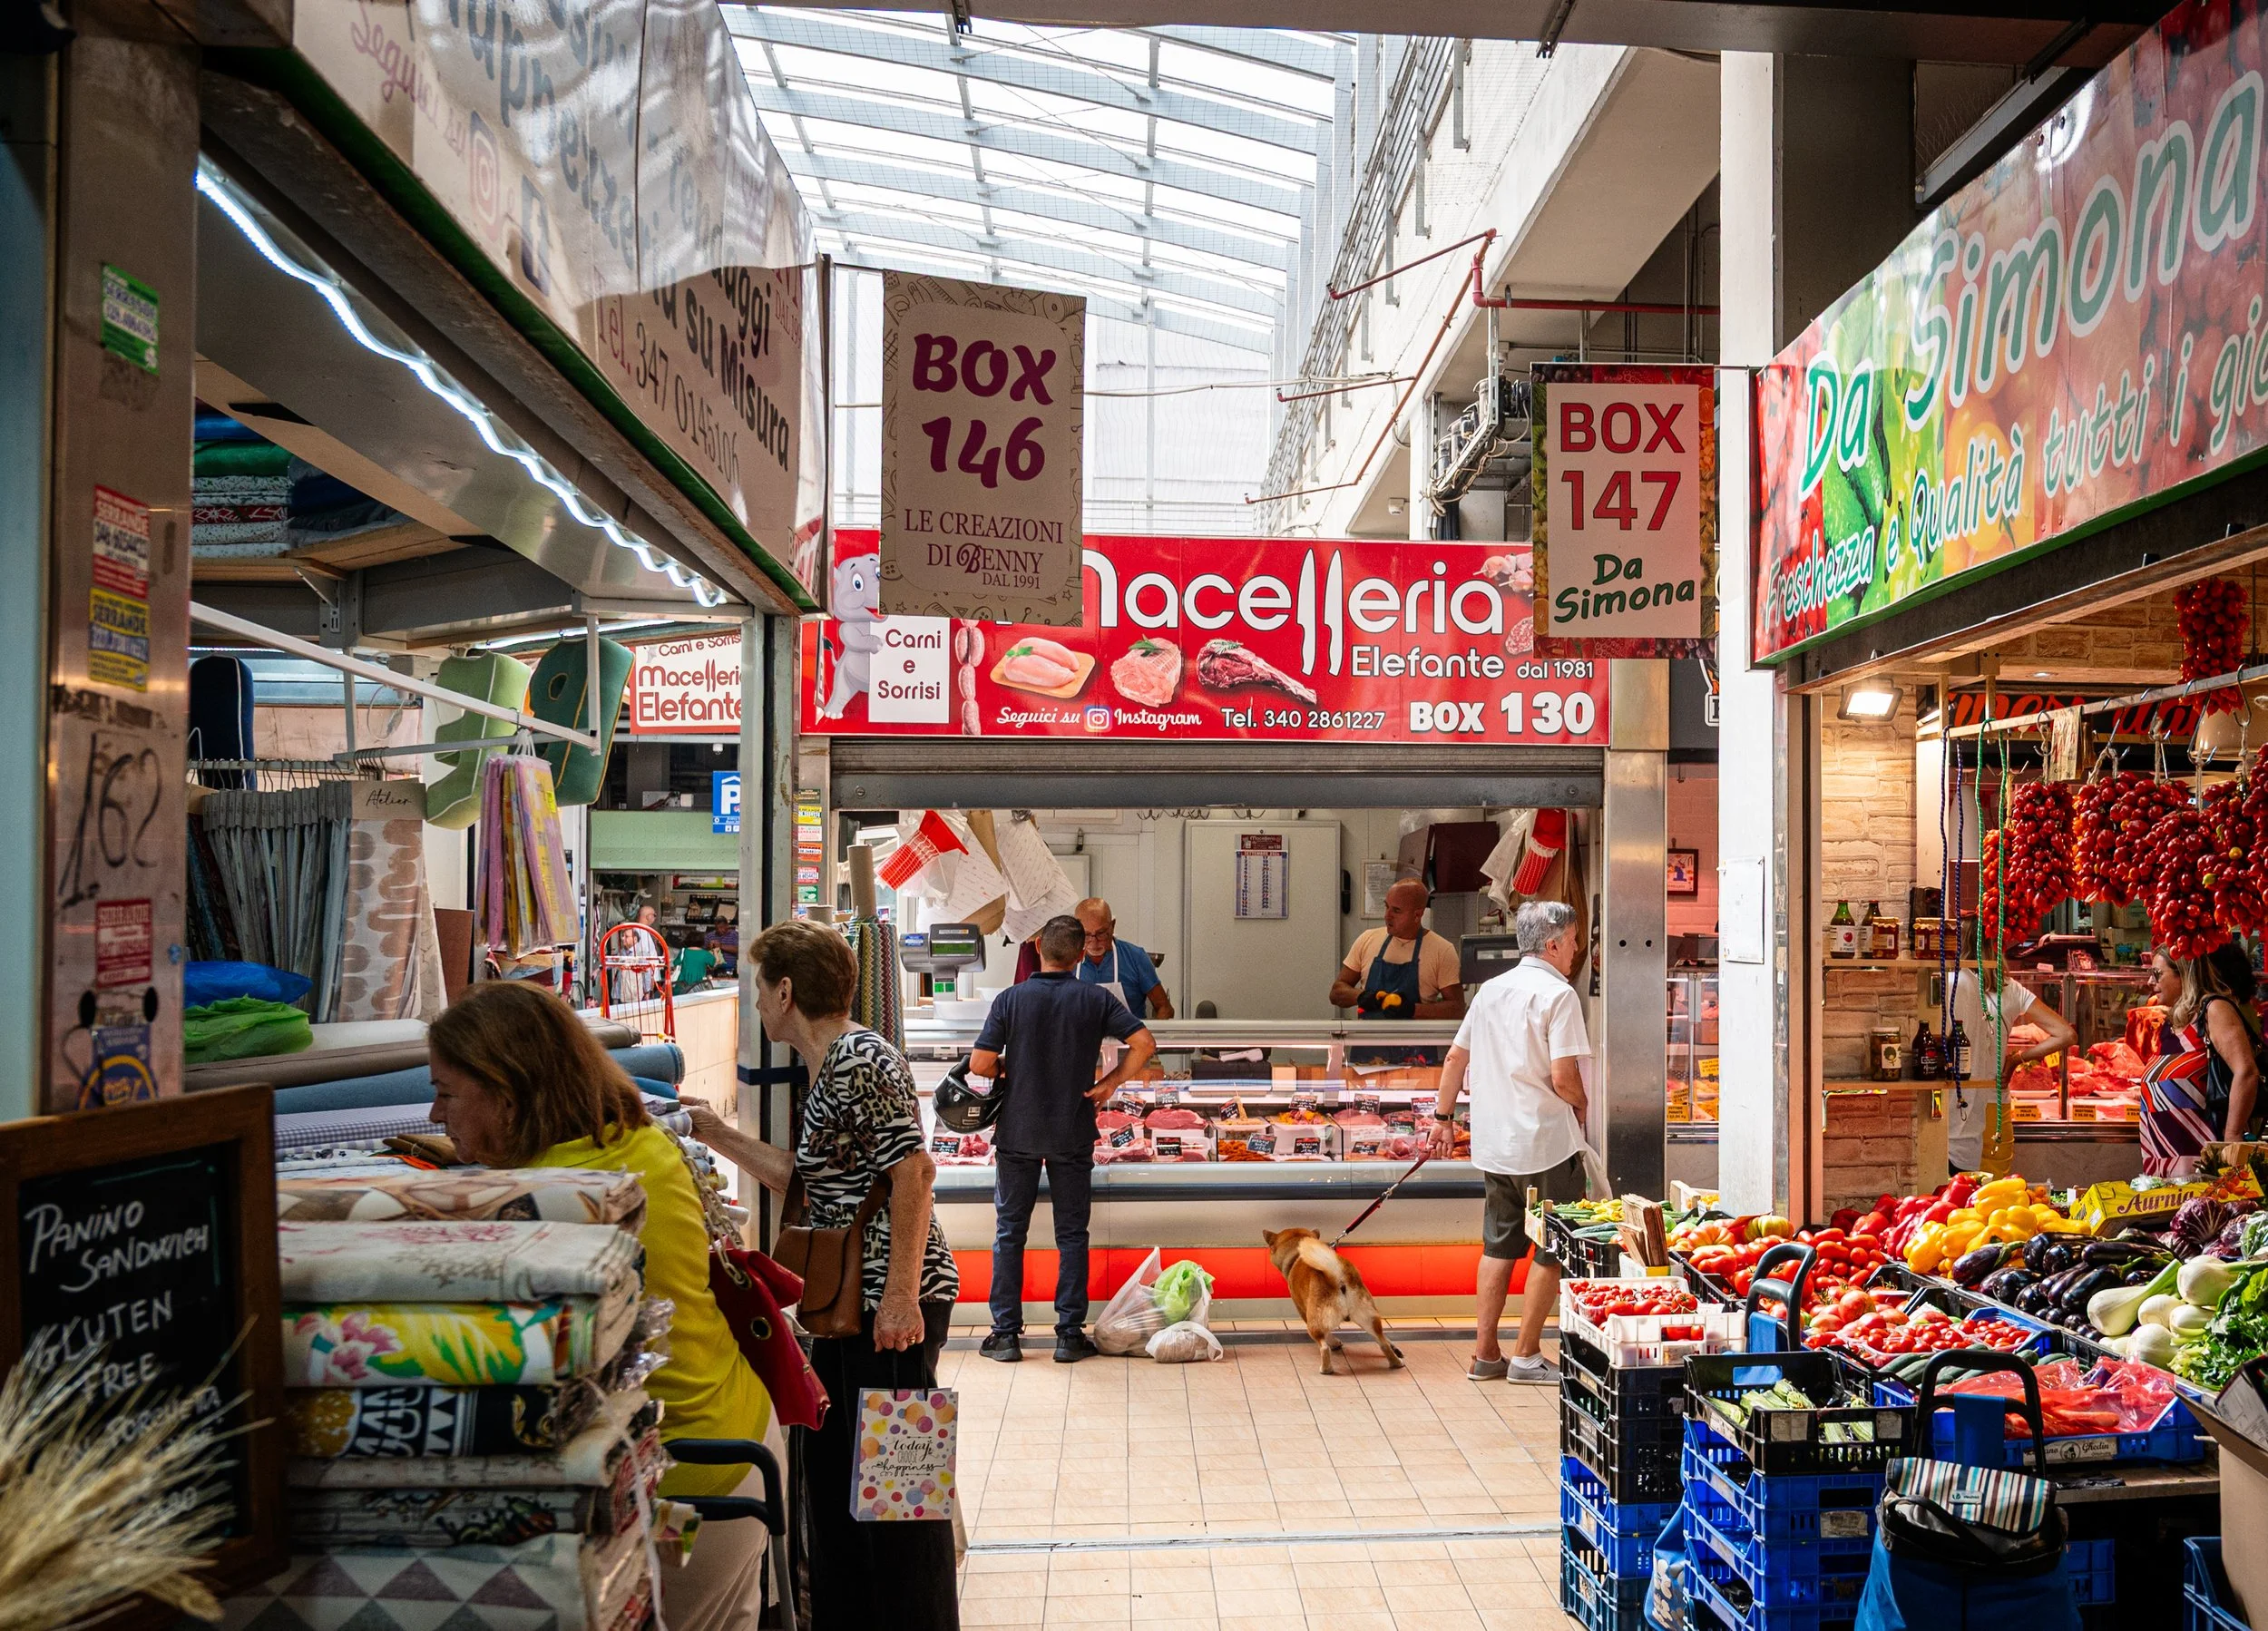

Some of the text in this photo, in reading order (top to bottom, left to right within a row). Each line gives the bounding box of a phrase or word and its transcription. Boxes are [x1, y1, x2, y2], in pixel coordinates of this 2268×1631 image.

[1798, 70, 2265, 503] Da Simona
[636, 321, 670, 412] 347
[686, 287, 715, 379] su
[720, 324, 790, 473] Misura
[912, 332, 1057, 406] BOX
[1560, 402, 1686, 454] BOX
[921, 415, 1046, 489] 146
[1561, 470, 1681, 531] 147
[1764, 523, 1875, 635] Freschezza
[1885, 514, 1901, 573] e
[1909, 424, 2026, 571] Qualità
[2043, 353, 2156, 500] tutti
[2169, 334, 2193, 448] i
[904, 508, 1064, 544] LE CREAZIONI
[927, 542, 1044, 574] DI BENNY
[1592, 553, 1643, 586] Da
[982, 571, 1041, 590] DAL 1991
[1553, 579, 1695, 623] Simona
[659, 635, 741, 656] Carni e Sorris
[885, 628, 942, 649] Carni
[639, 659, 741, 692] Macelleri
[903, 660, 915, 674] e
[1351, 645, 1595, 679] Elefante dal 1981
[877, 679, 941, 700] Sorrisi
[996, 707, 1203, 731] Seguici su Instagram
[1221, 707, 1385, 730] Tel. 340 2861227
[1409, 691, 1596, 735] BOX 130
[366, 788, 413, 808] Atelier
[894, 1439, 934, 1461] today
[876, 1459, 942, 1477] happiness
